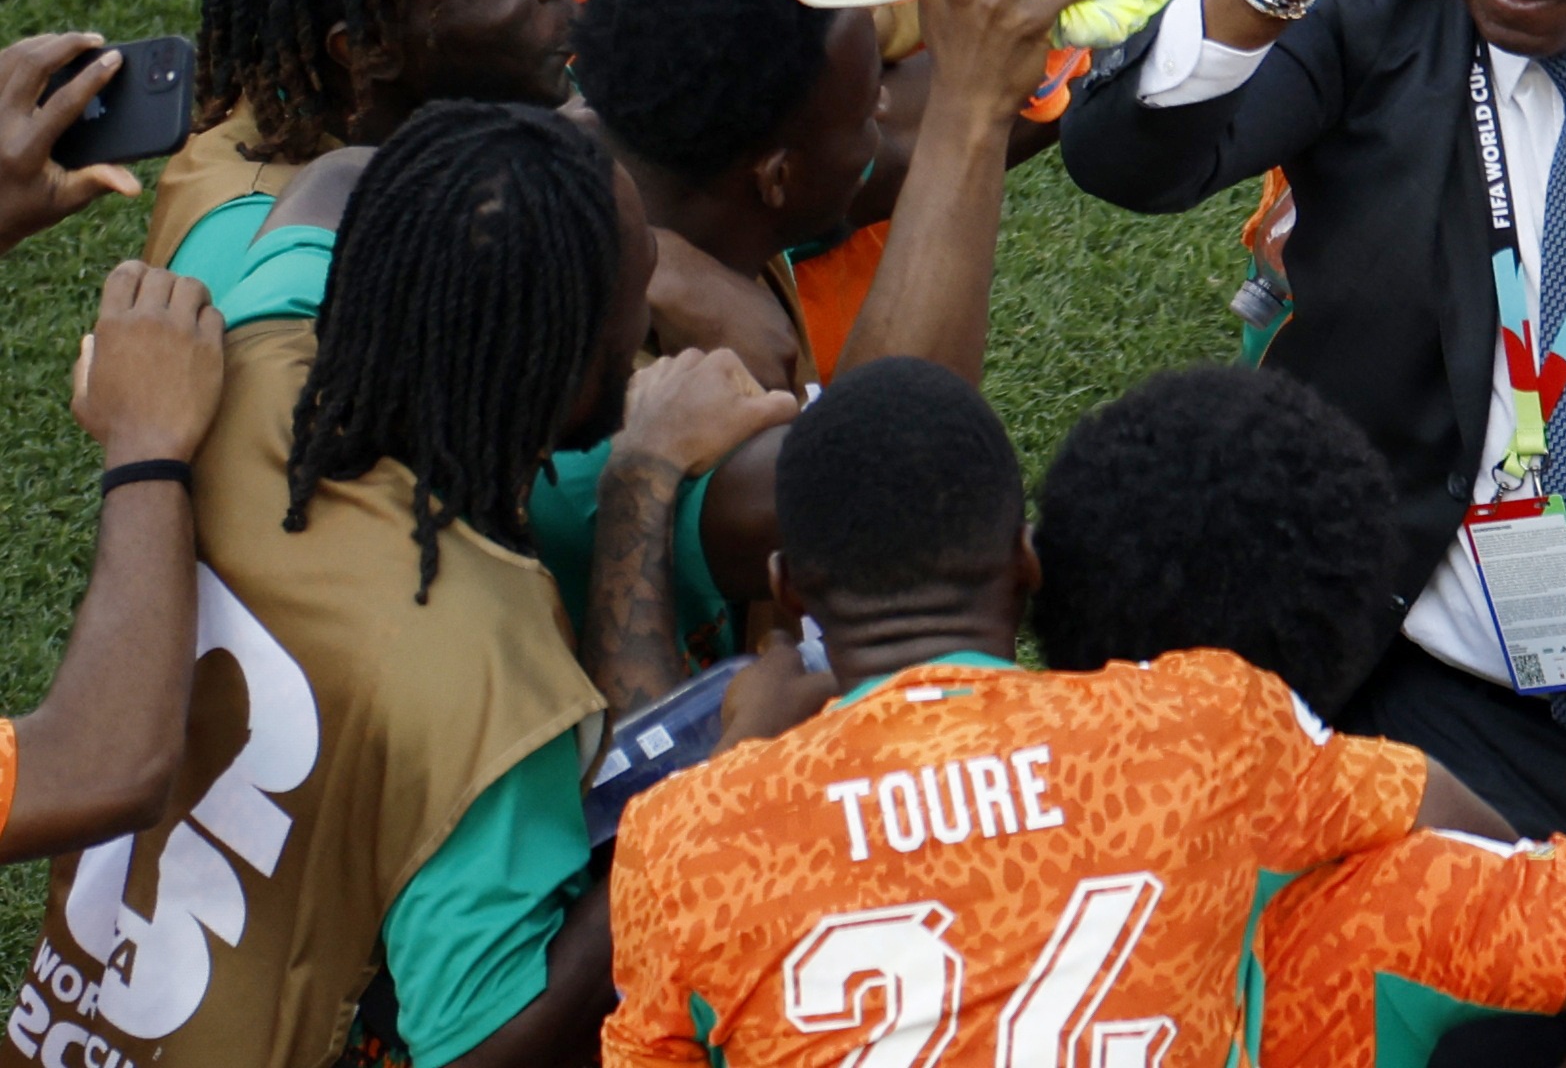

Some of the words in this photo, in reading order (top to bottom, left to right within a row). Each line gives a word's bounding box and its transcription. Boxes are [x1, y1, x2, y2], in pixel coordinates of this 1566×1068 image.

[1476, 107, 1503, 182] WORLD
[1489, 182, 1511, 230] FIFA
[828, 746, 1065, 861] TOURE
[784, 869, 1178, 1068] 24
